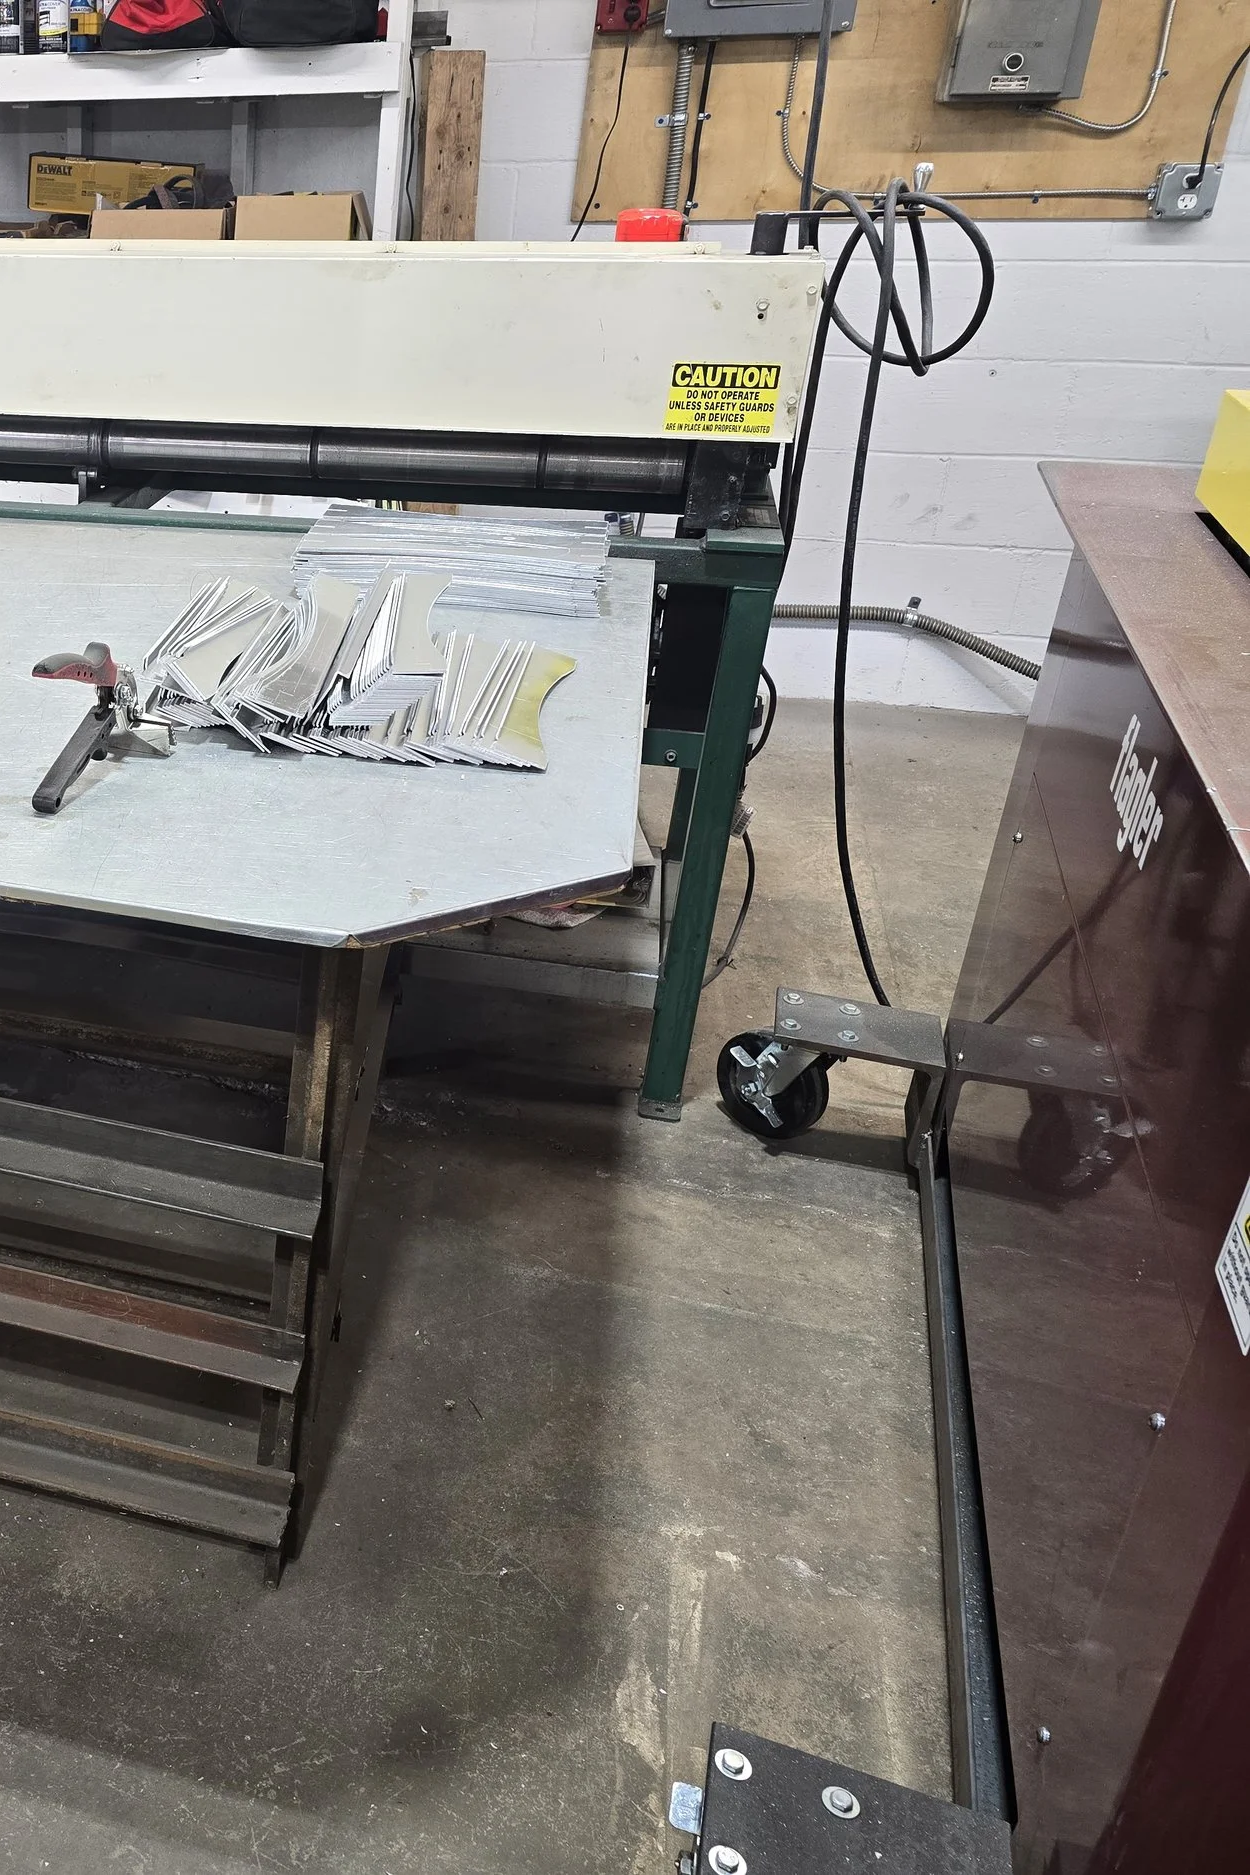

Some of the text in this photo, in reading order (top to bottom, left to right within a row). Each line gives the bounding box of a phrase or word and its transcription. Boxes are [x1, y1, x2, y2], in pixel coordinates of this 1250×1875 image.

[674, 364, 778, 389] CAUTION
[686, 390, 760, 401] DO NOT OPERATE
[668, 401, 775, 412] UNLESS SAFETY GUARDS
[694, 412, 745, 423] OR DEVICES
[665, 423, 676, 431] ARE
[677, 423, 683, 431] IN
[702, 424, 713, 432] AND
[714, 424, 741, 433] PROPERLY
[742, 425, 770, 434] ADJUSTED
[1109, 714, 1164, 871] flagler
